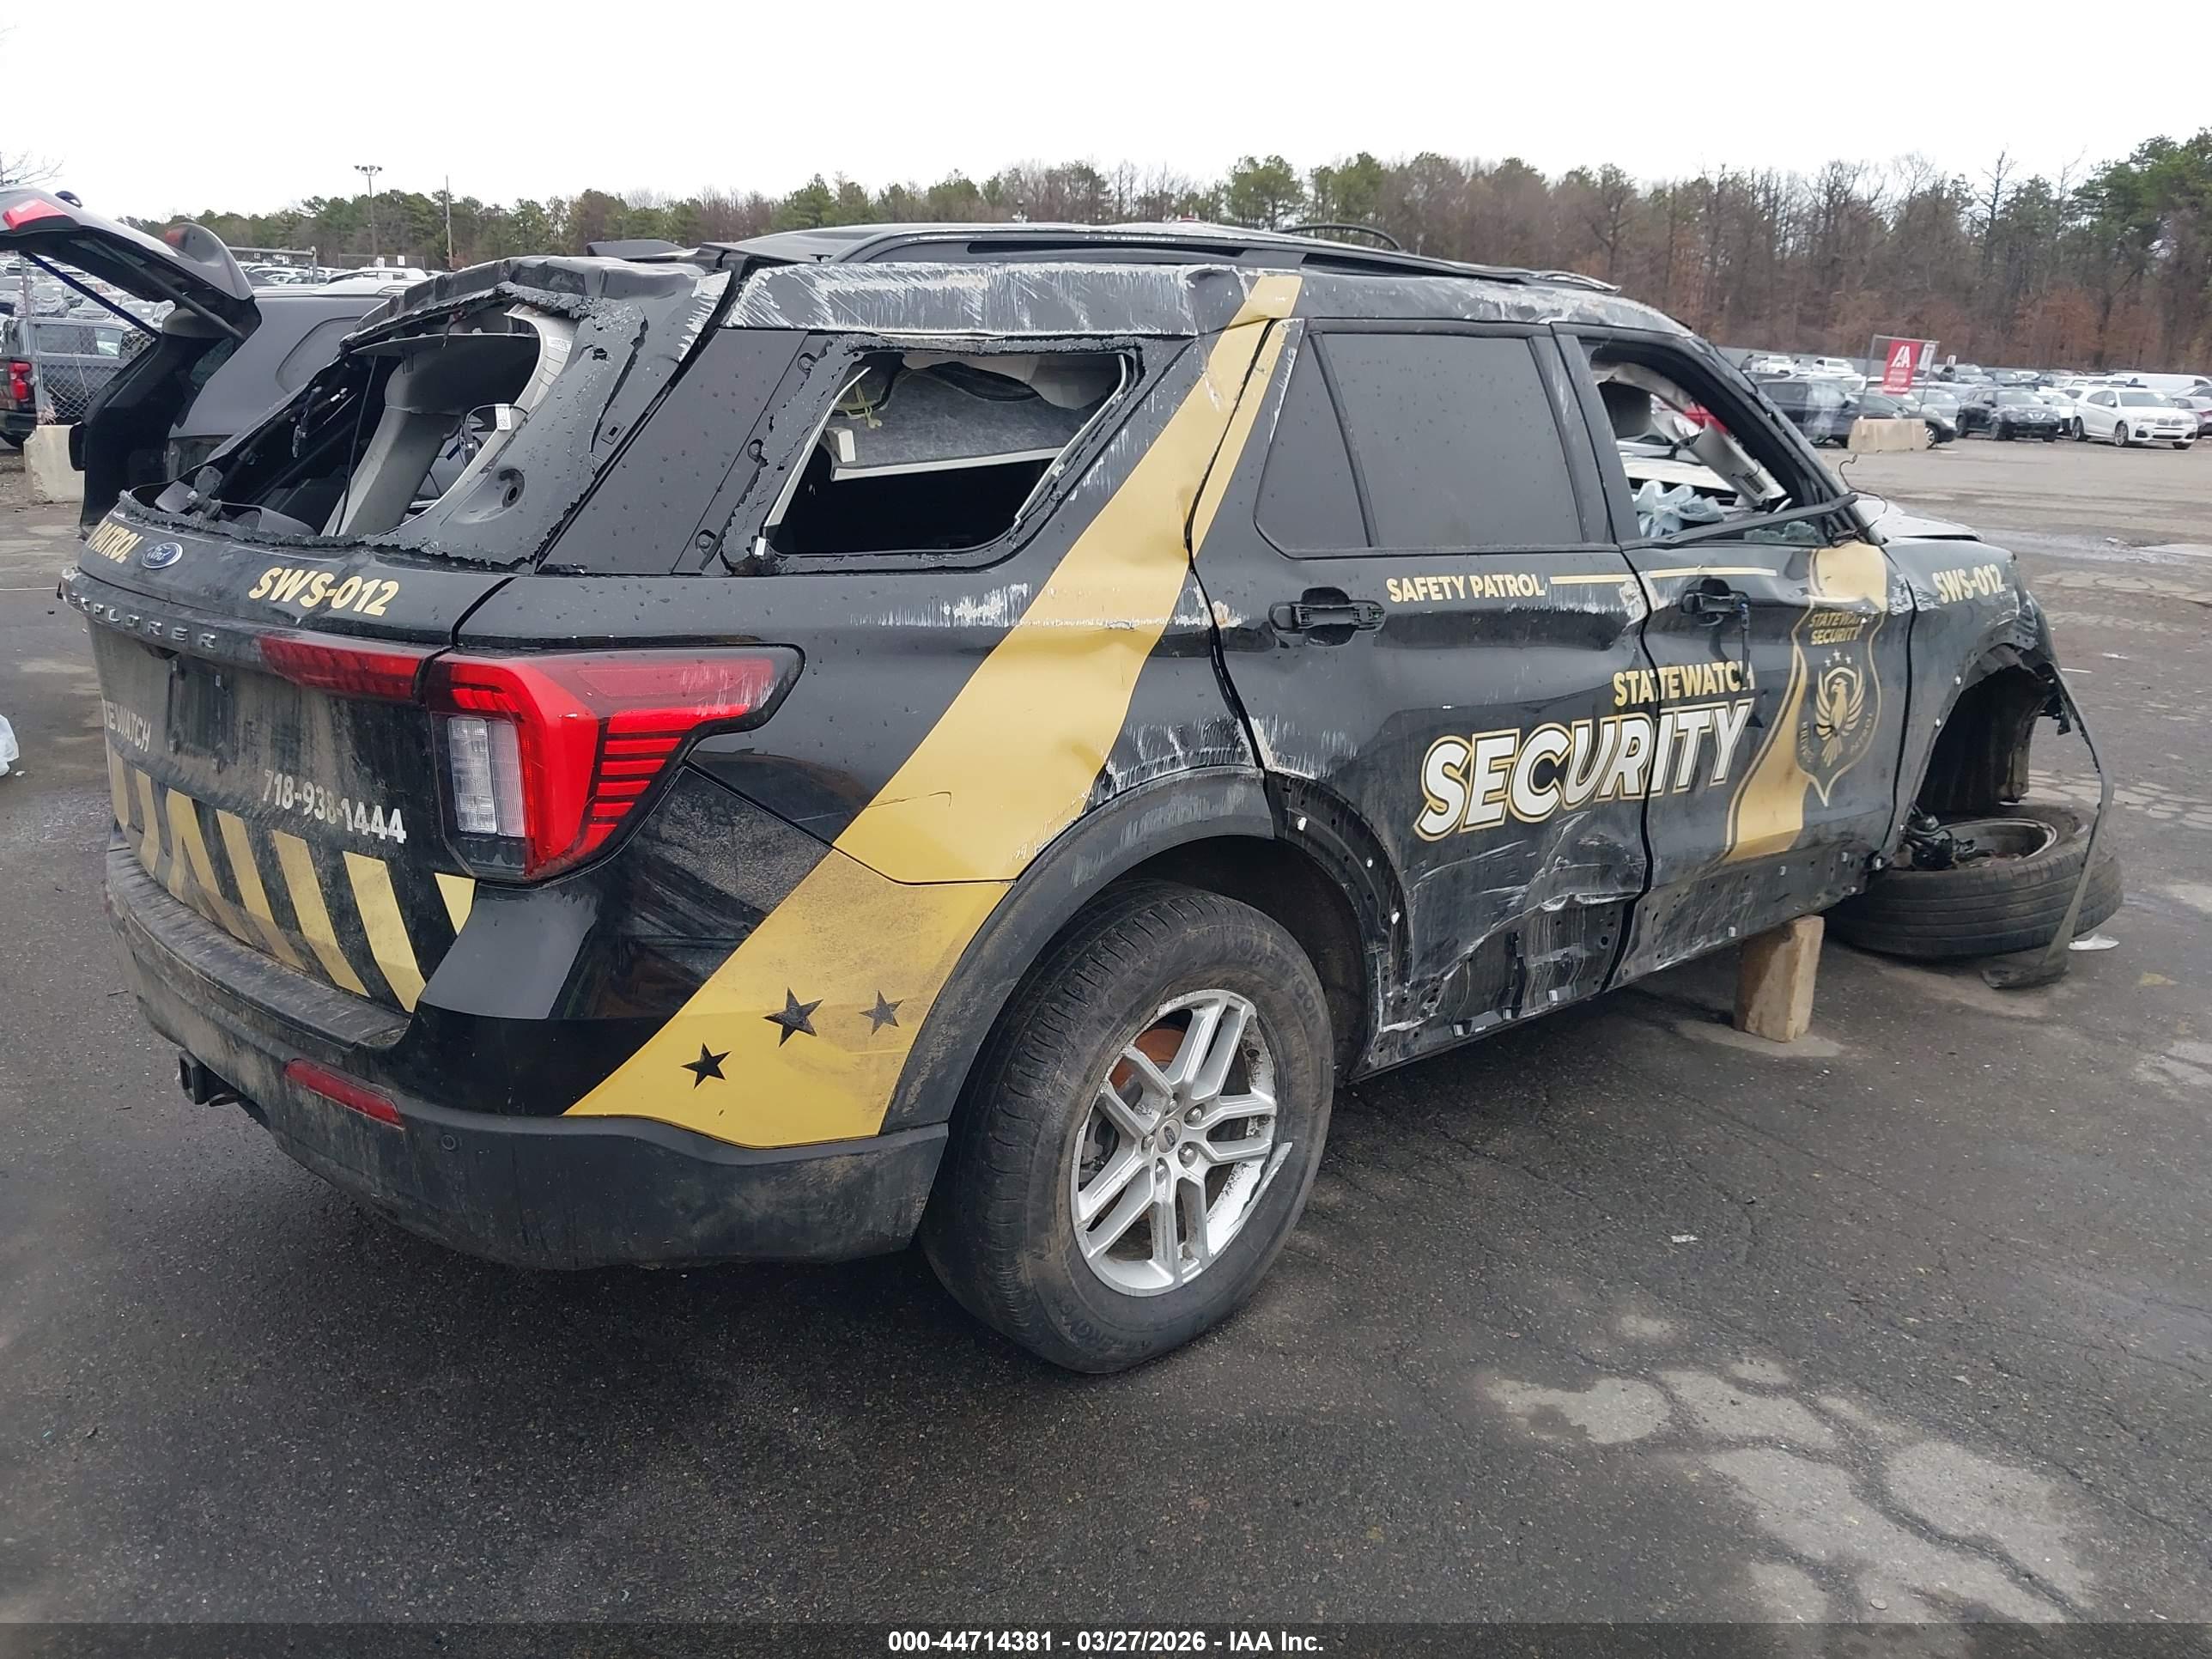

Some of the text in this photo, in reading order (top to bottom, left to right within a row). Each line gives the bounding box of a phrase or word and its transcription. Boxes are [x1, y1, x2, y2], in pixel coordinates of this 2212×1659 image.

[248, 567, 399, 617] SWS-012
[1386, 574, 1546, 603] SAFETY PATROL
[1932, 563, 2006, 604] SWS-012
[70, 592, 216, 649] EXPLORER
[1811, 626, 1862, 645] SECURITY
[1413, 697, 1753, 842] SECURITY
[263, 769, 407, 844] 718-938-1444
